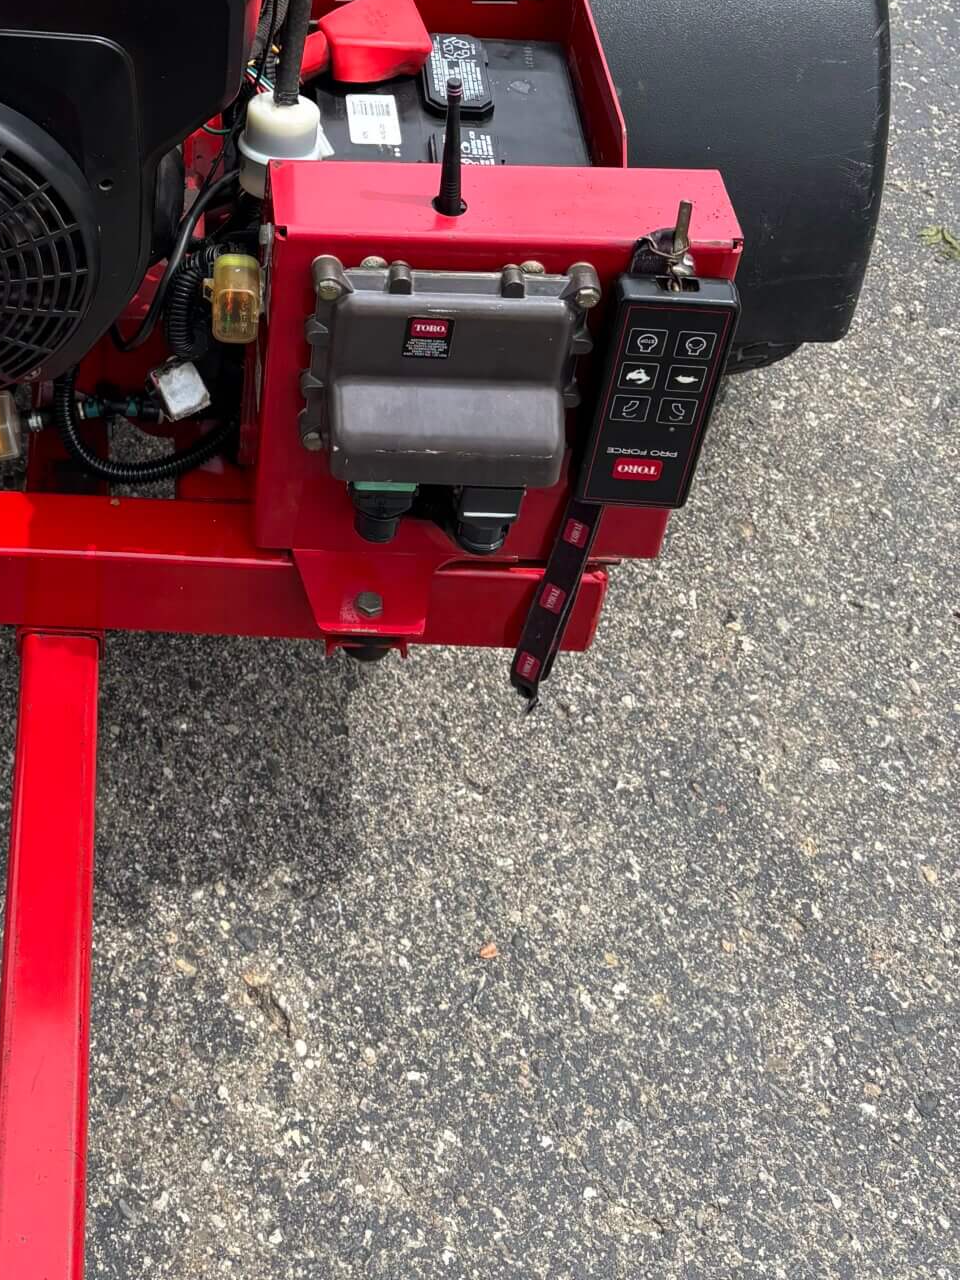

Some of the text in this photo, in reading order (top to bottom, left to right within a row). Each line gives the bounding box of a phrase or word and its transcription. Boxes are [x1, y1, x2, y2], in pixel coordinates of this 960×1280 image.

[415, 324, 446, 333] TORO
[606, 446, 678, 458] PRO FORCE
[617, 464, 657, 476] TORO
